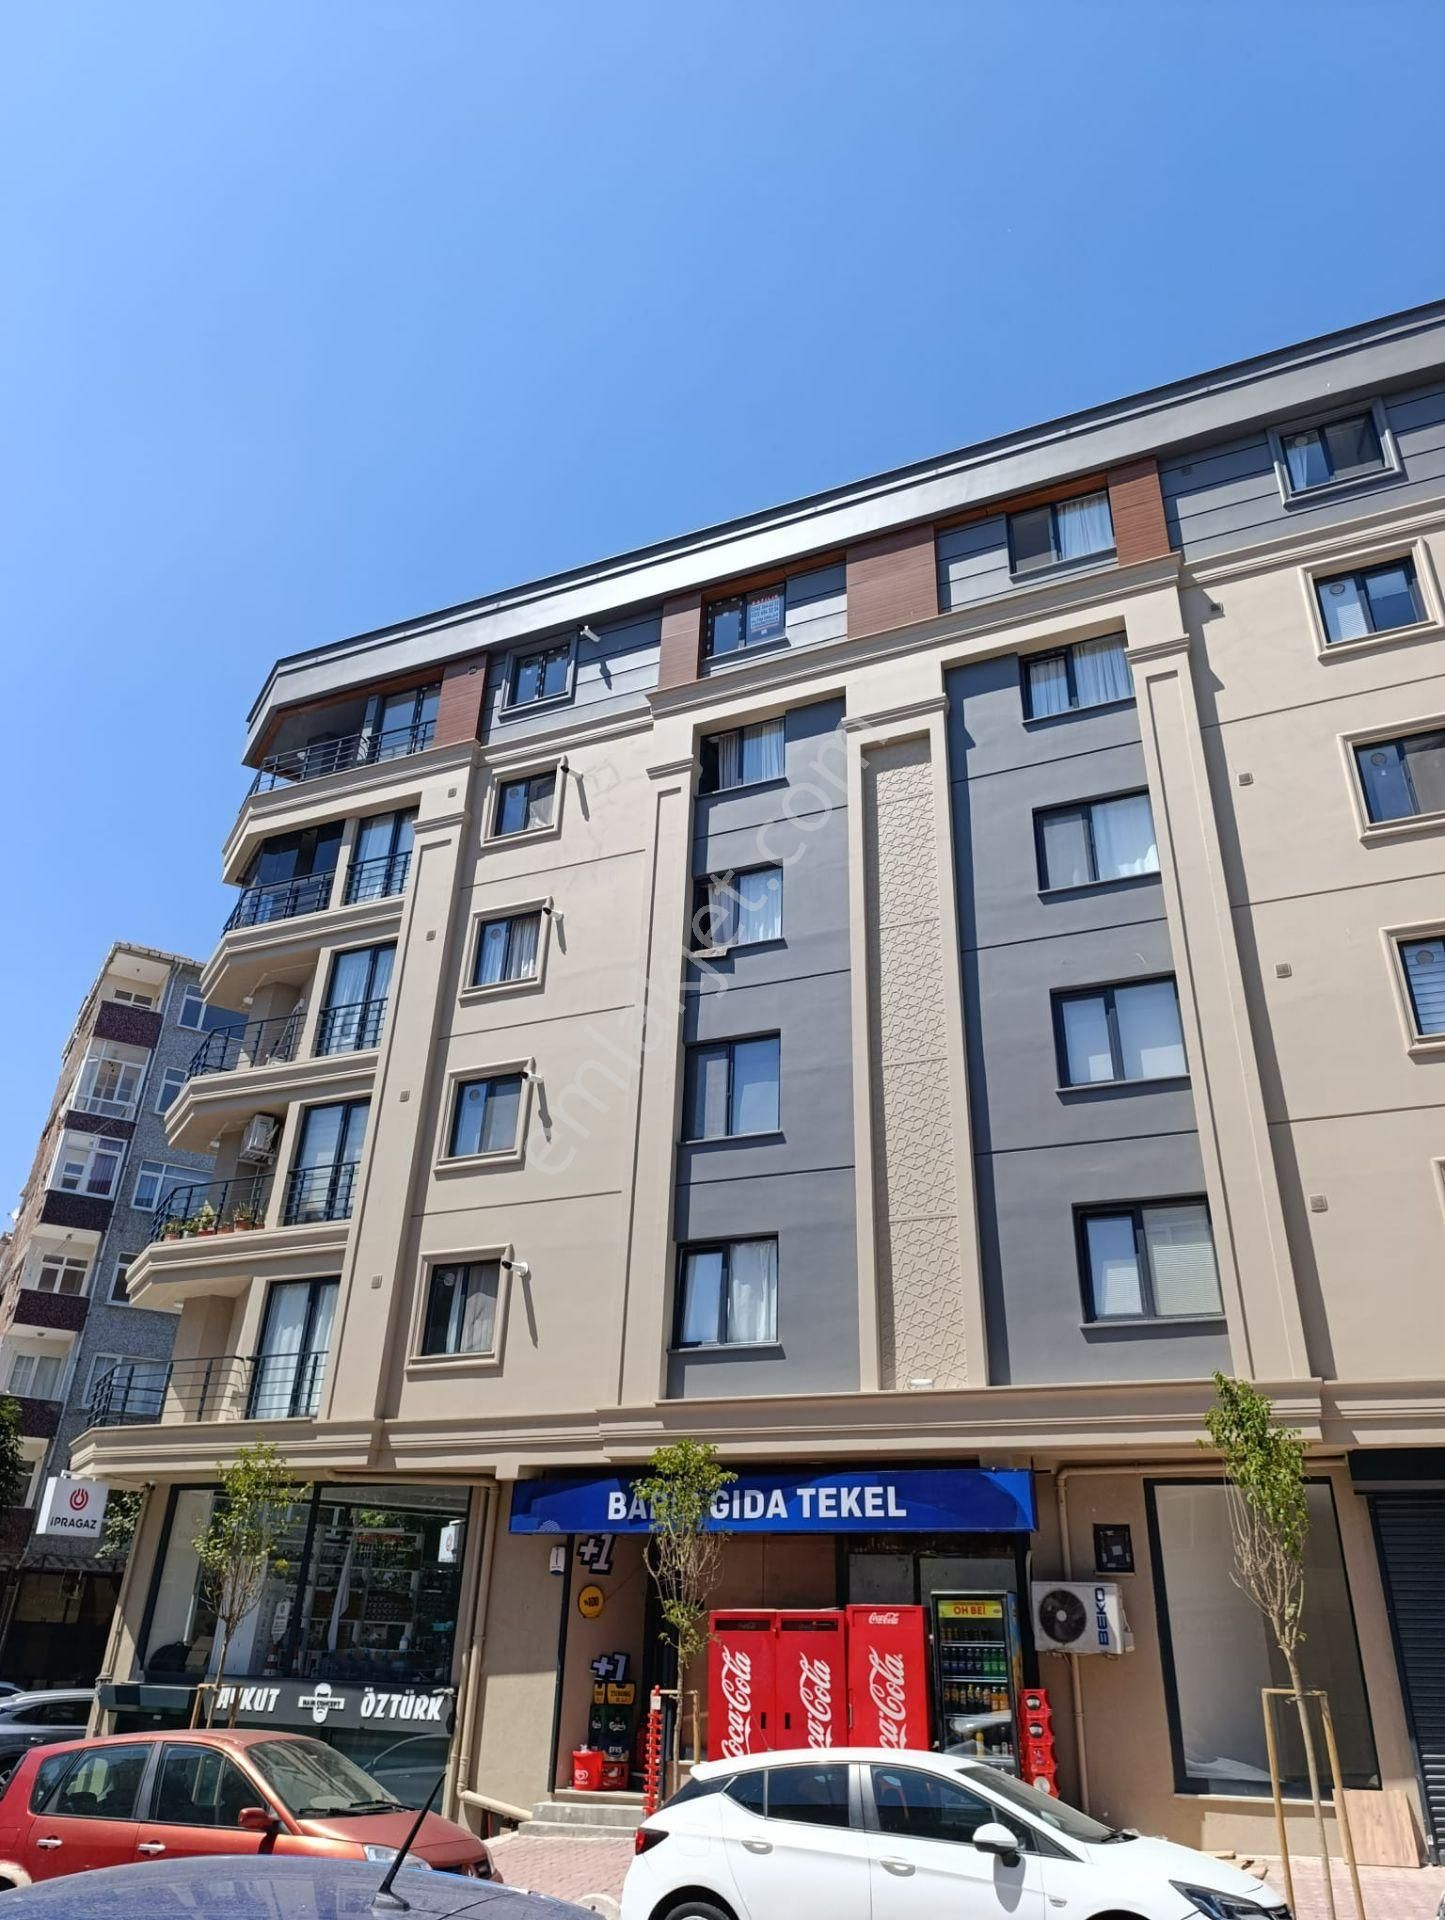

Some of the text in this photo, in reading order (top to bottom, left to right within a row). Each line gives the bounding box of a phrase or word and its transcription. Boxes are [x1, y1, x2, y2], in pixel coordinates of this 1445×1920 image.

[710, 1489, 788, 1519] GIDA
[797, 1486, 907, 1518] TEKEL
[1095, 1587, 1110, 1646] BEKO
[360, 1686, 445, 1721] ÖZTÜRK
